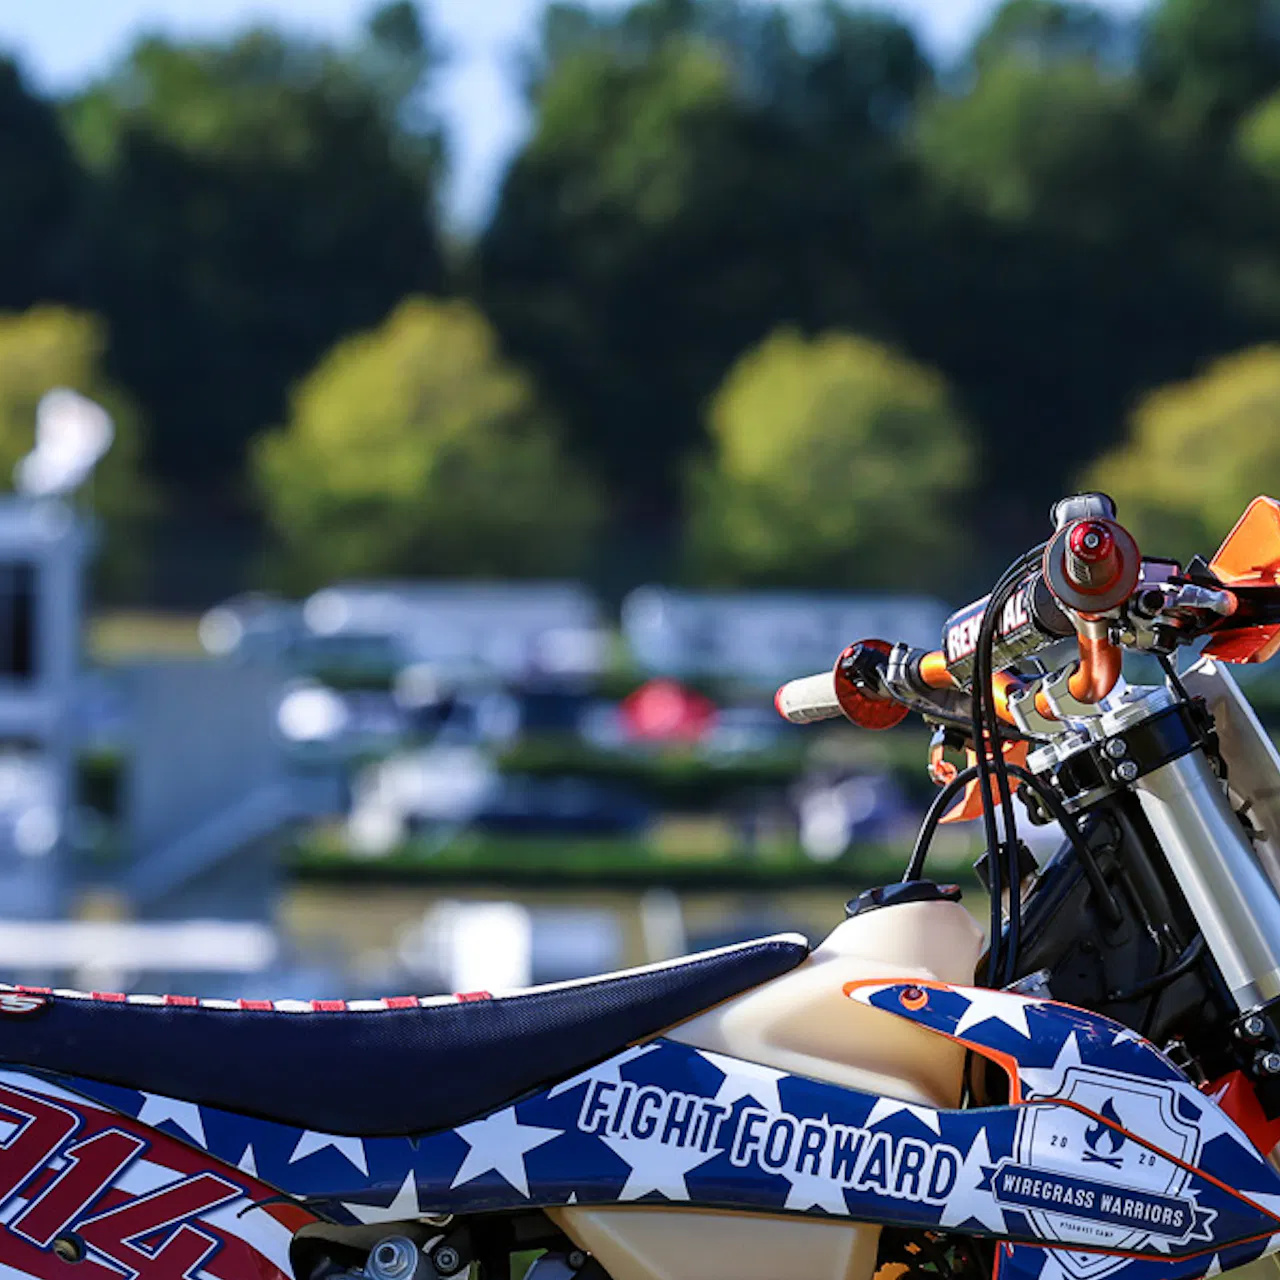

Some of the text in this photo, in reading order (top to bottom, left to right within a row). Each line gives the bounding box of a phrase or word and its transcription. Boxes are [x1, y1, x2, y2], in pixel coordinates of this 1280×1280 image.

[578, 1080, 965, 1206] FIGHT FORWARD
[1002, 1173, 1184, 1228] WIREGRASS WARRIORS
